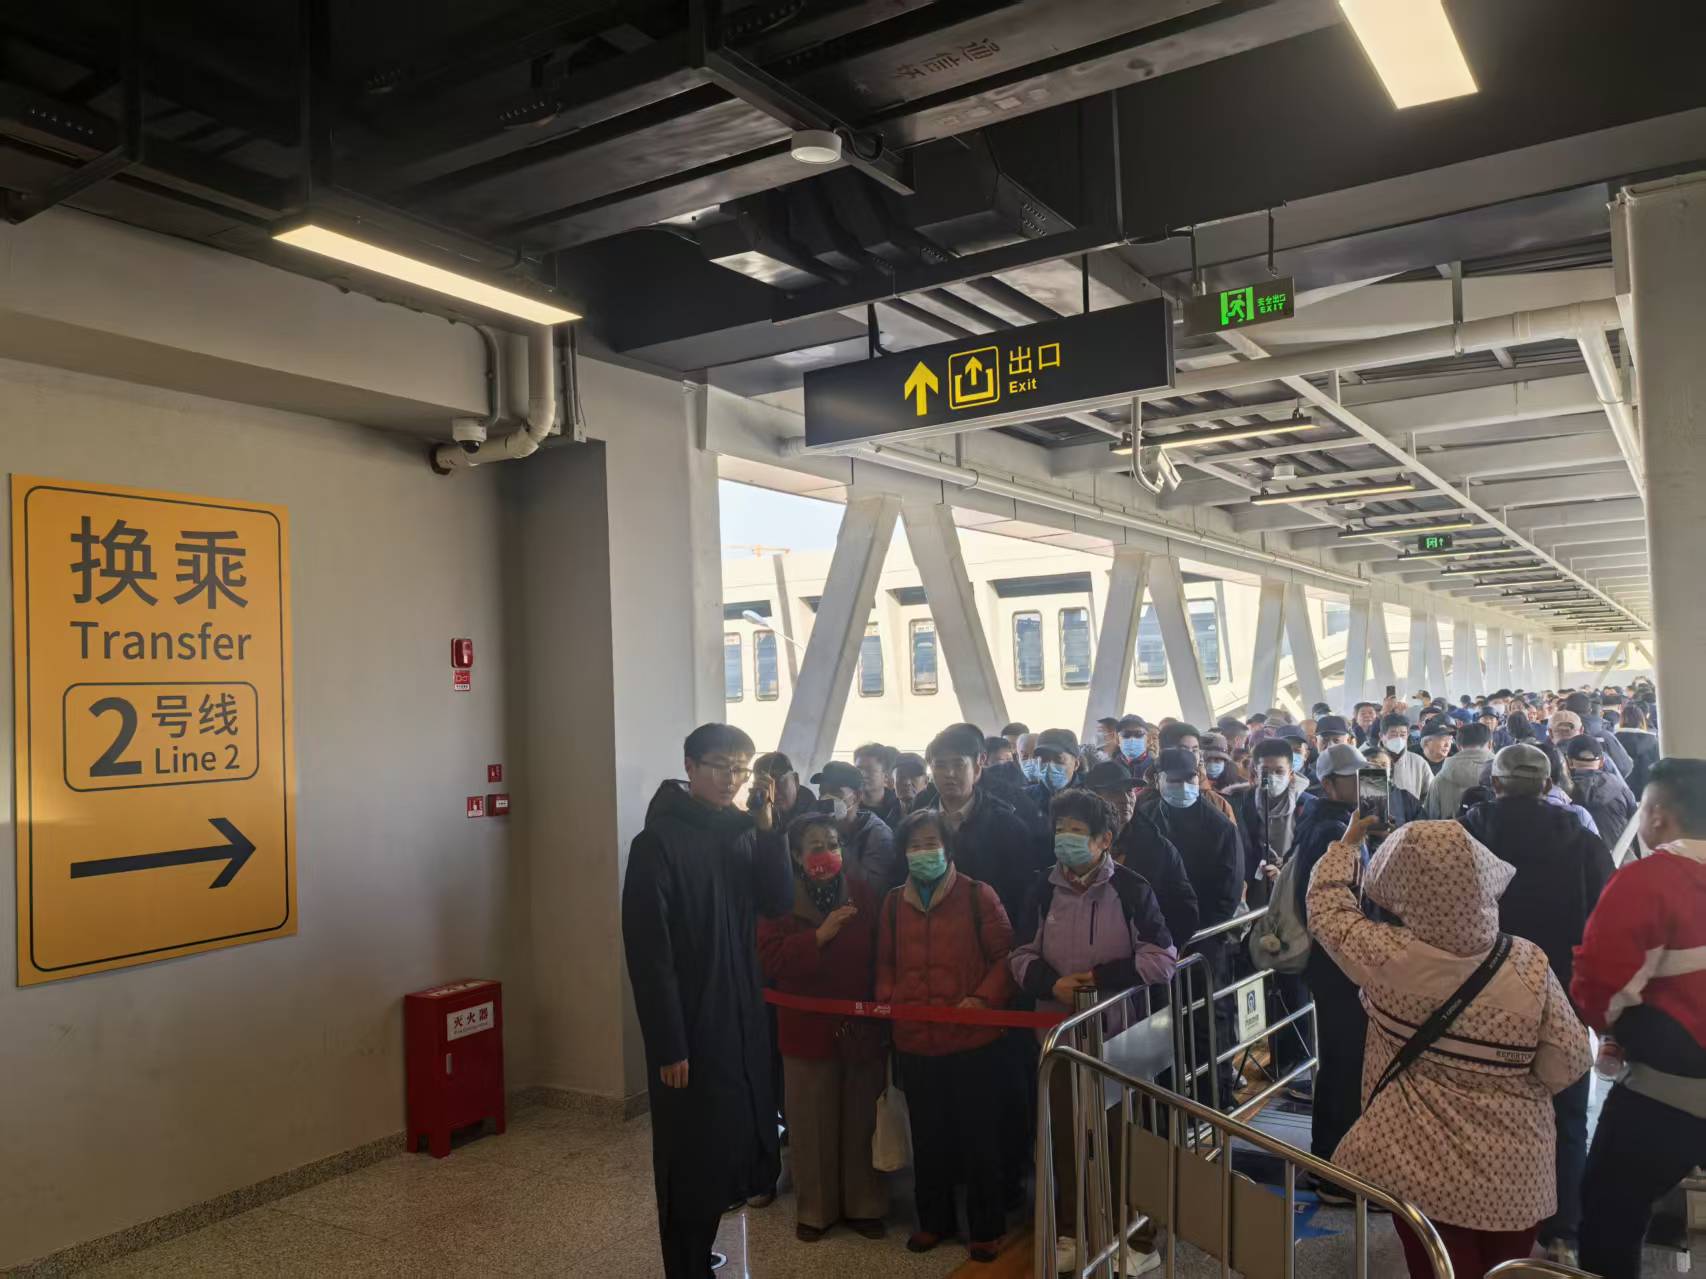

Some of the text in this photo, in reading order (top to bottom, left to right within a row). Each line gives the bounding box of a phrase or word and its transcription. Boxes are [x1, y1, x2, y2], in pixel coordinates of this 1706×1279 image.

[1257, 293, 1287, 307] 安全出口
[1259, 302, 1285, 314] EXIT
[1008, 342, 1061, 375] 出口
[1008, 378, 1038, 394] Exit
[69, 515, 249, 610] 换乘
[69, 621, 252, 660] Transfer
[155, 743, 241, 774] Line 2
